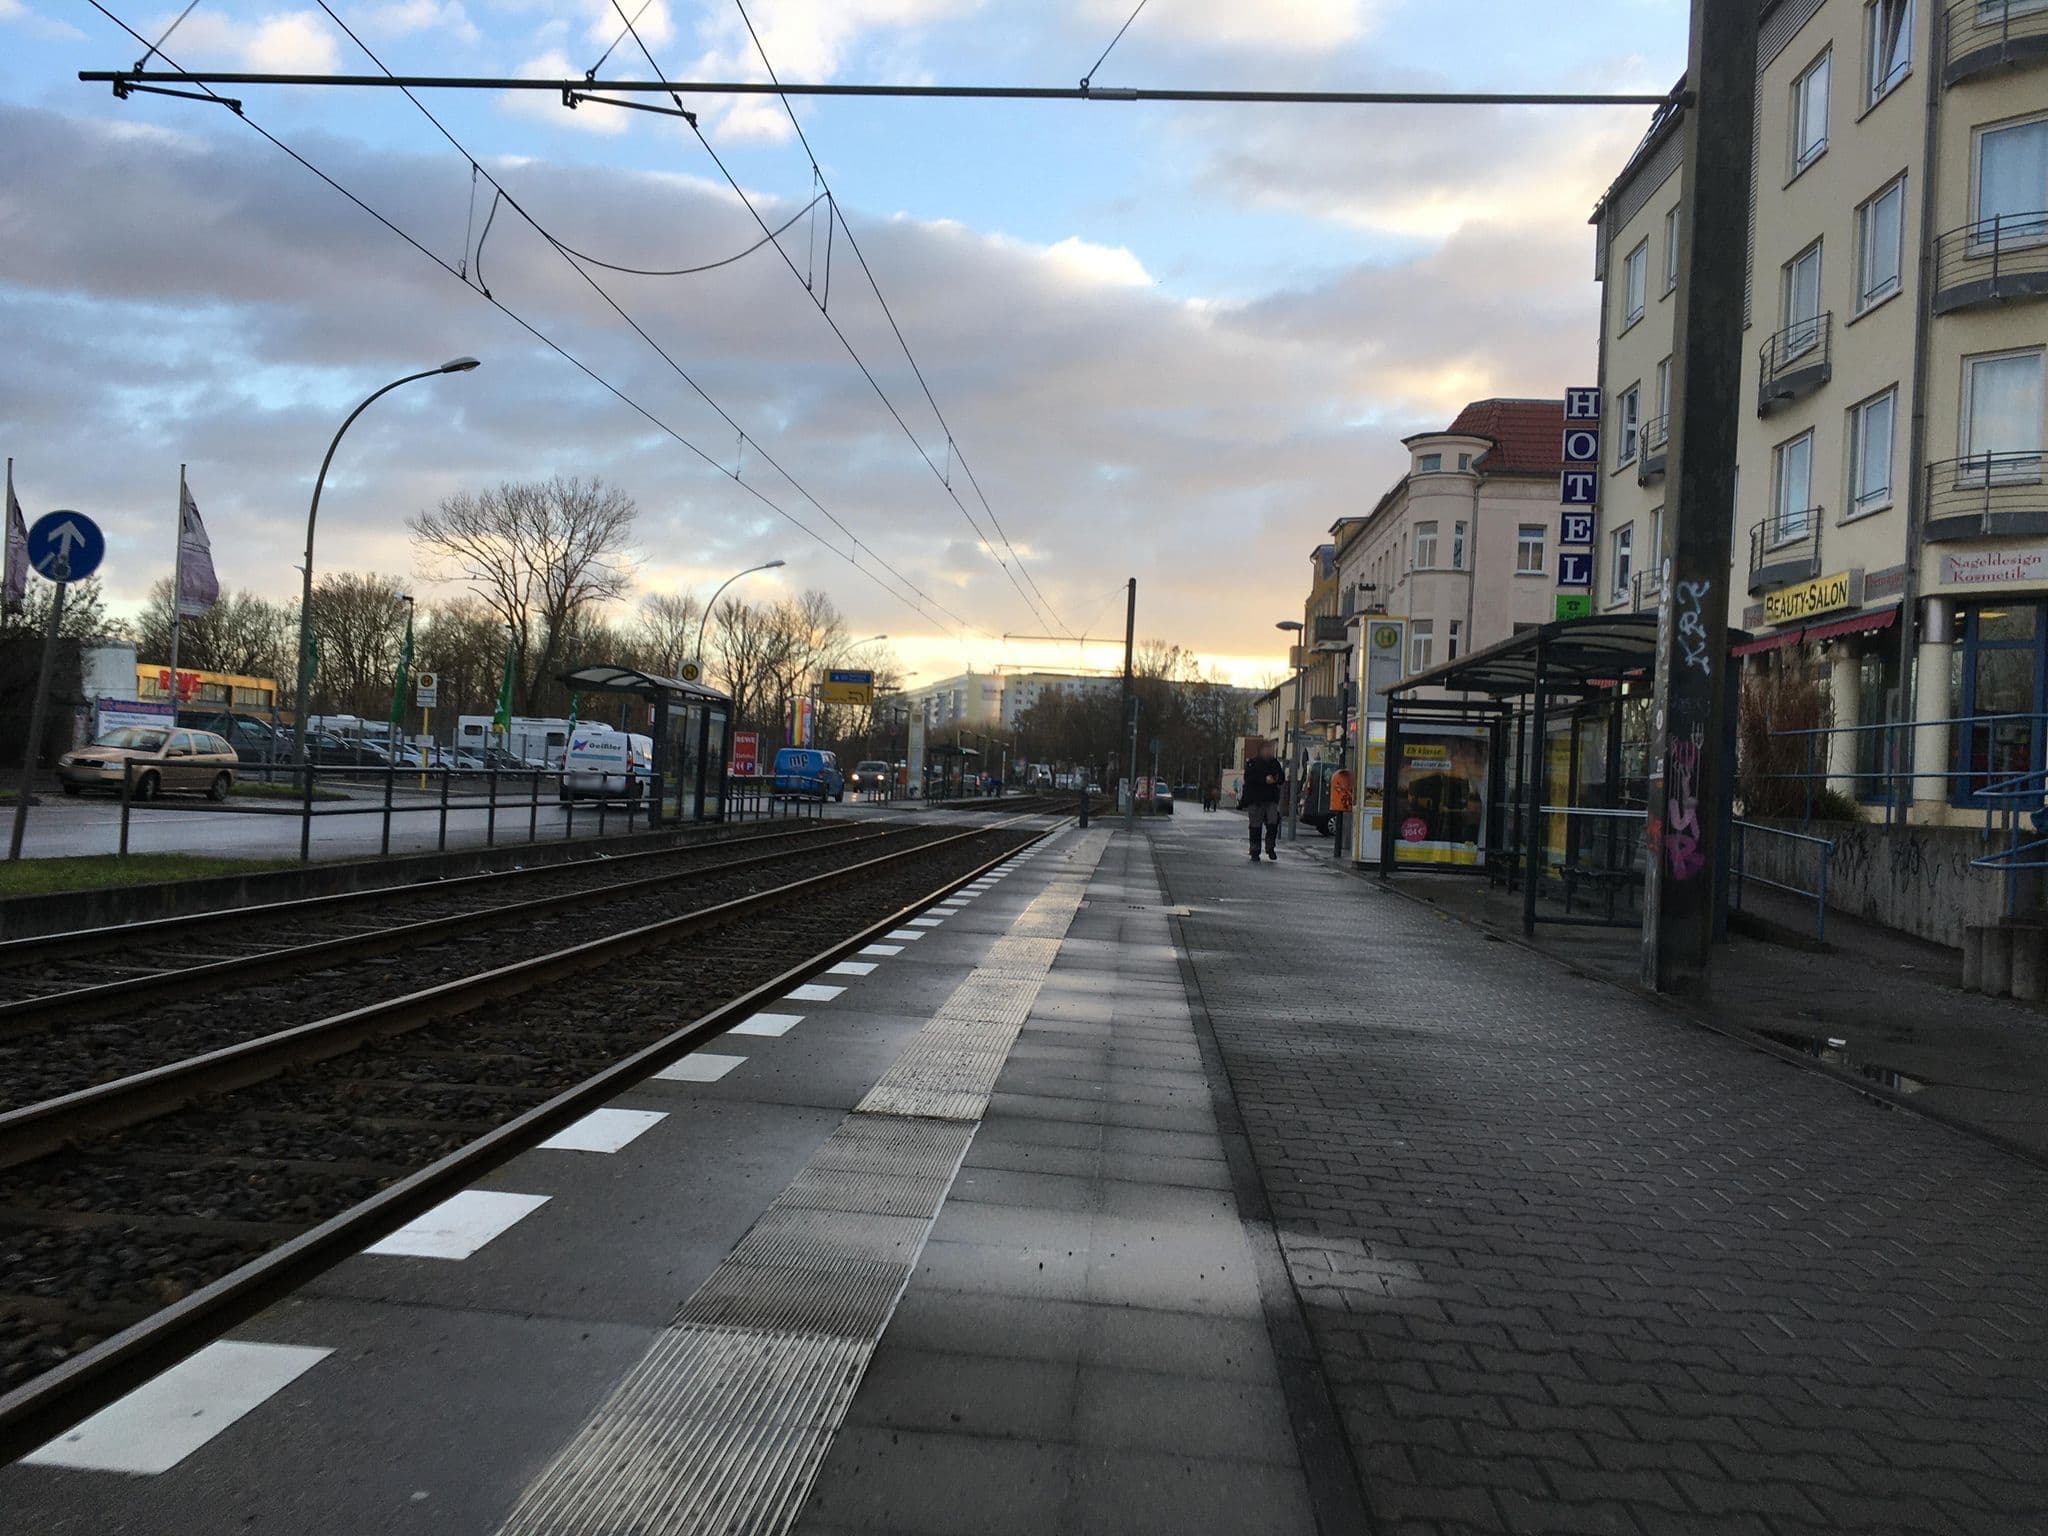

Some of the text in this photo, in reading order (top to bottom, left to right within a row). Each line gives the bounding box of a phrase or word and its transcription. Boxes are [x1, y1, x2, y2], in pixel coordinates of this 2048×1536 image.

[1563, 391, 1599, 583] HOTEL
[1950, 553, 2041, 568] Nageldesign
[1953, 566, 2026, 583] Kosmetik
